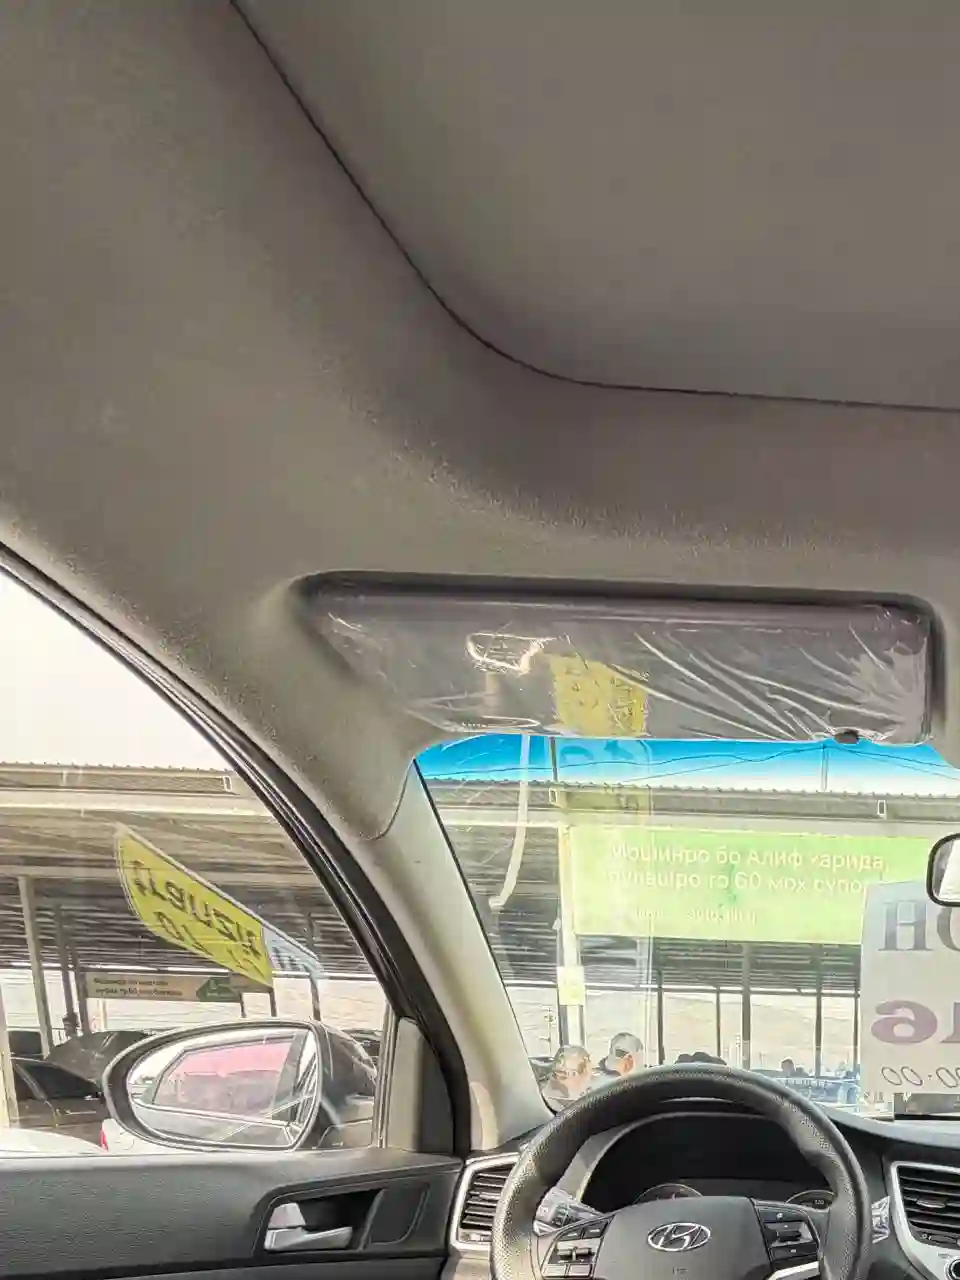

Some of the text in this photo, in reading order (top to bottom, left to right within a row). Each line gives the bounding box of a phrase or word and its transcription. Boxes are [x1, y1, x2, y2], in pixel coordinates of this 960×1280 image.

[716, 845, 742, 865] бо
[747, 845, 804, 872] Алиф
[734, 870, 762, 891] 60
